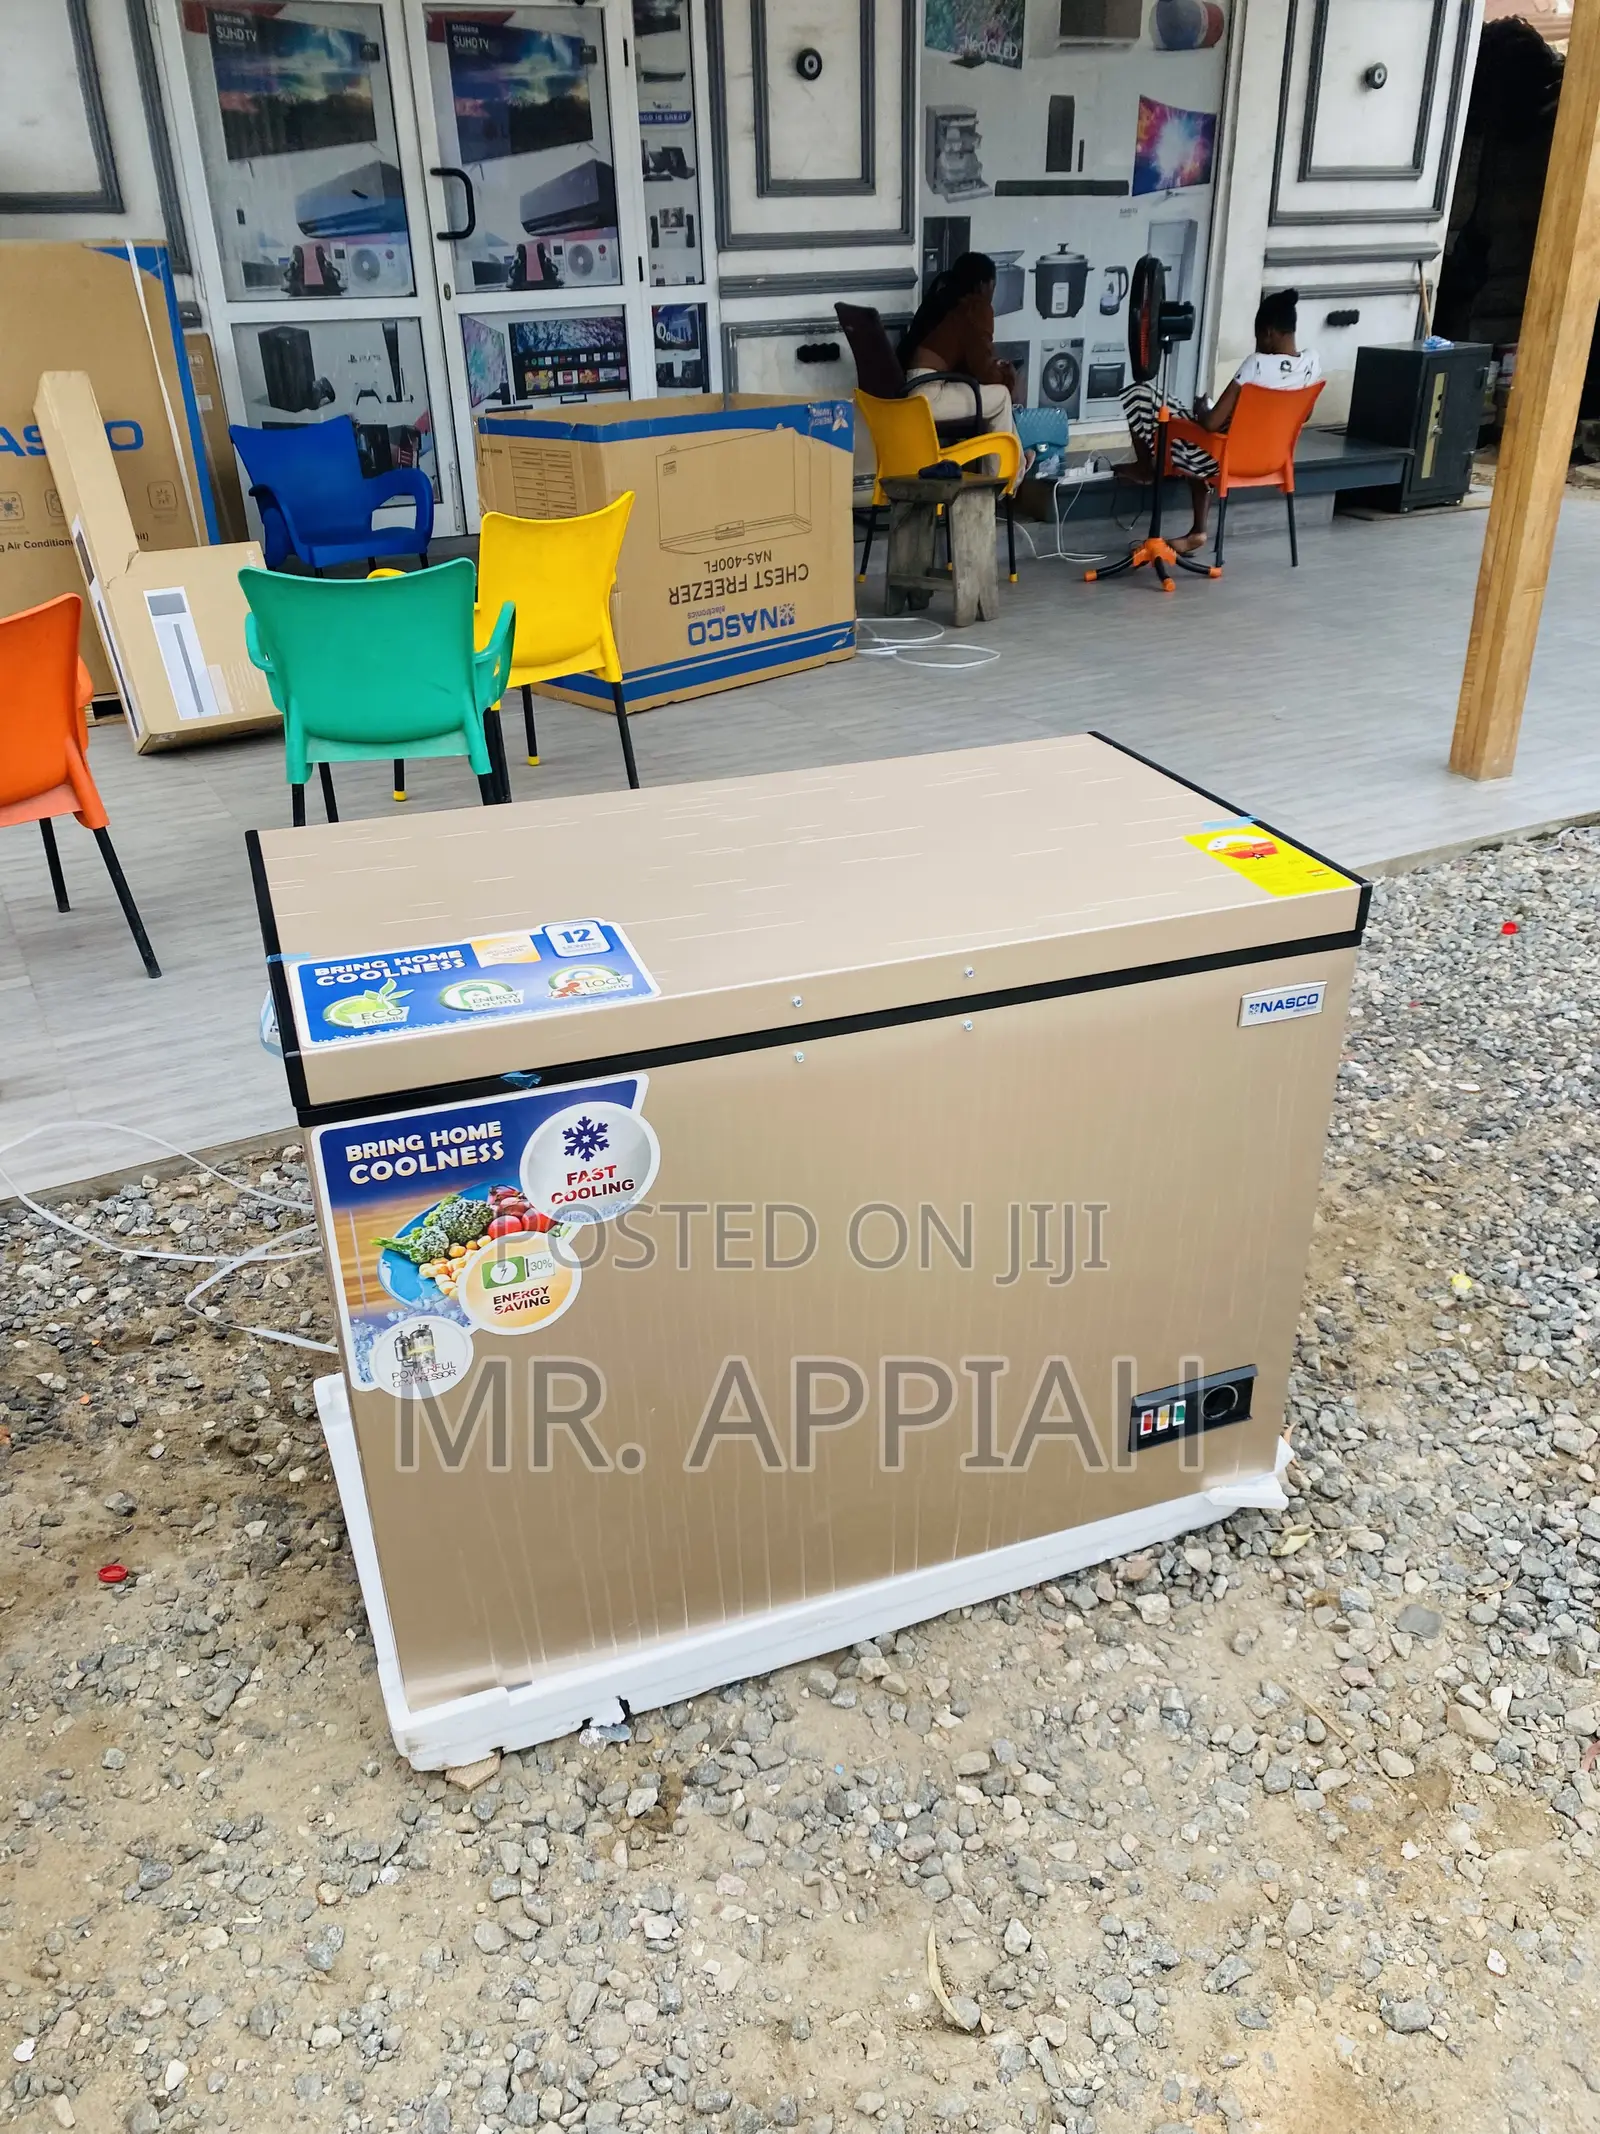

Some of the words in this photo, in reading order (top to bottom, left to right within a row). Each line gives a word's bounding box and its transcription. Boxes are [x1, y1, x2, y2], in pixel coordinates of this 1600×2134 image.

[7, 540, 21, 550] Air
[704, 549, 772, 574] NAS-400FL
[753, 563, 809, 590] CHEST
[668, 573, 748, 605] FREEZER
[687, 605, 726, 619] electronics
[687, 605, 778, 646] NASCO
[558, 929, 594, 943] 12
[314, 960, 388, 976] BRING
[394, 950, 463, 966] HOME
[316, 958, 466, 986] COOLNESS
[585, 976, 628, 988] LOCK
[472, 992, 520, 1004] ENERGY
[1260, 993, 1319, 1013] NASCO
[361, 1008, 404, 1020] ECO
[363, 1015, 405, 1025] friendly
[345, 1134, 424, 1161] BRING
[430, 1120, 502, 1147] HOME
[349, 1140, 504, 1184] COOLNESS
[566, 1165, 617, 1186] FAST
[551, 1179, 634, 1204] COOLING
[530, 1259, 552, 1271] 30%
[493, 1286, 549, 1305] ENERGY
[494, 1296, 551, 1315] SAVING
